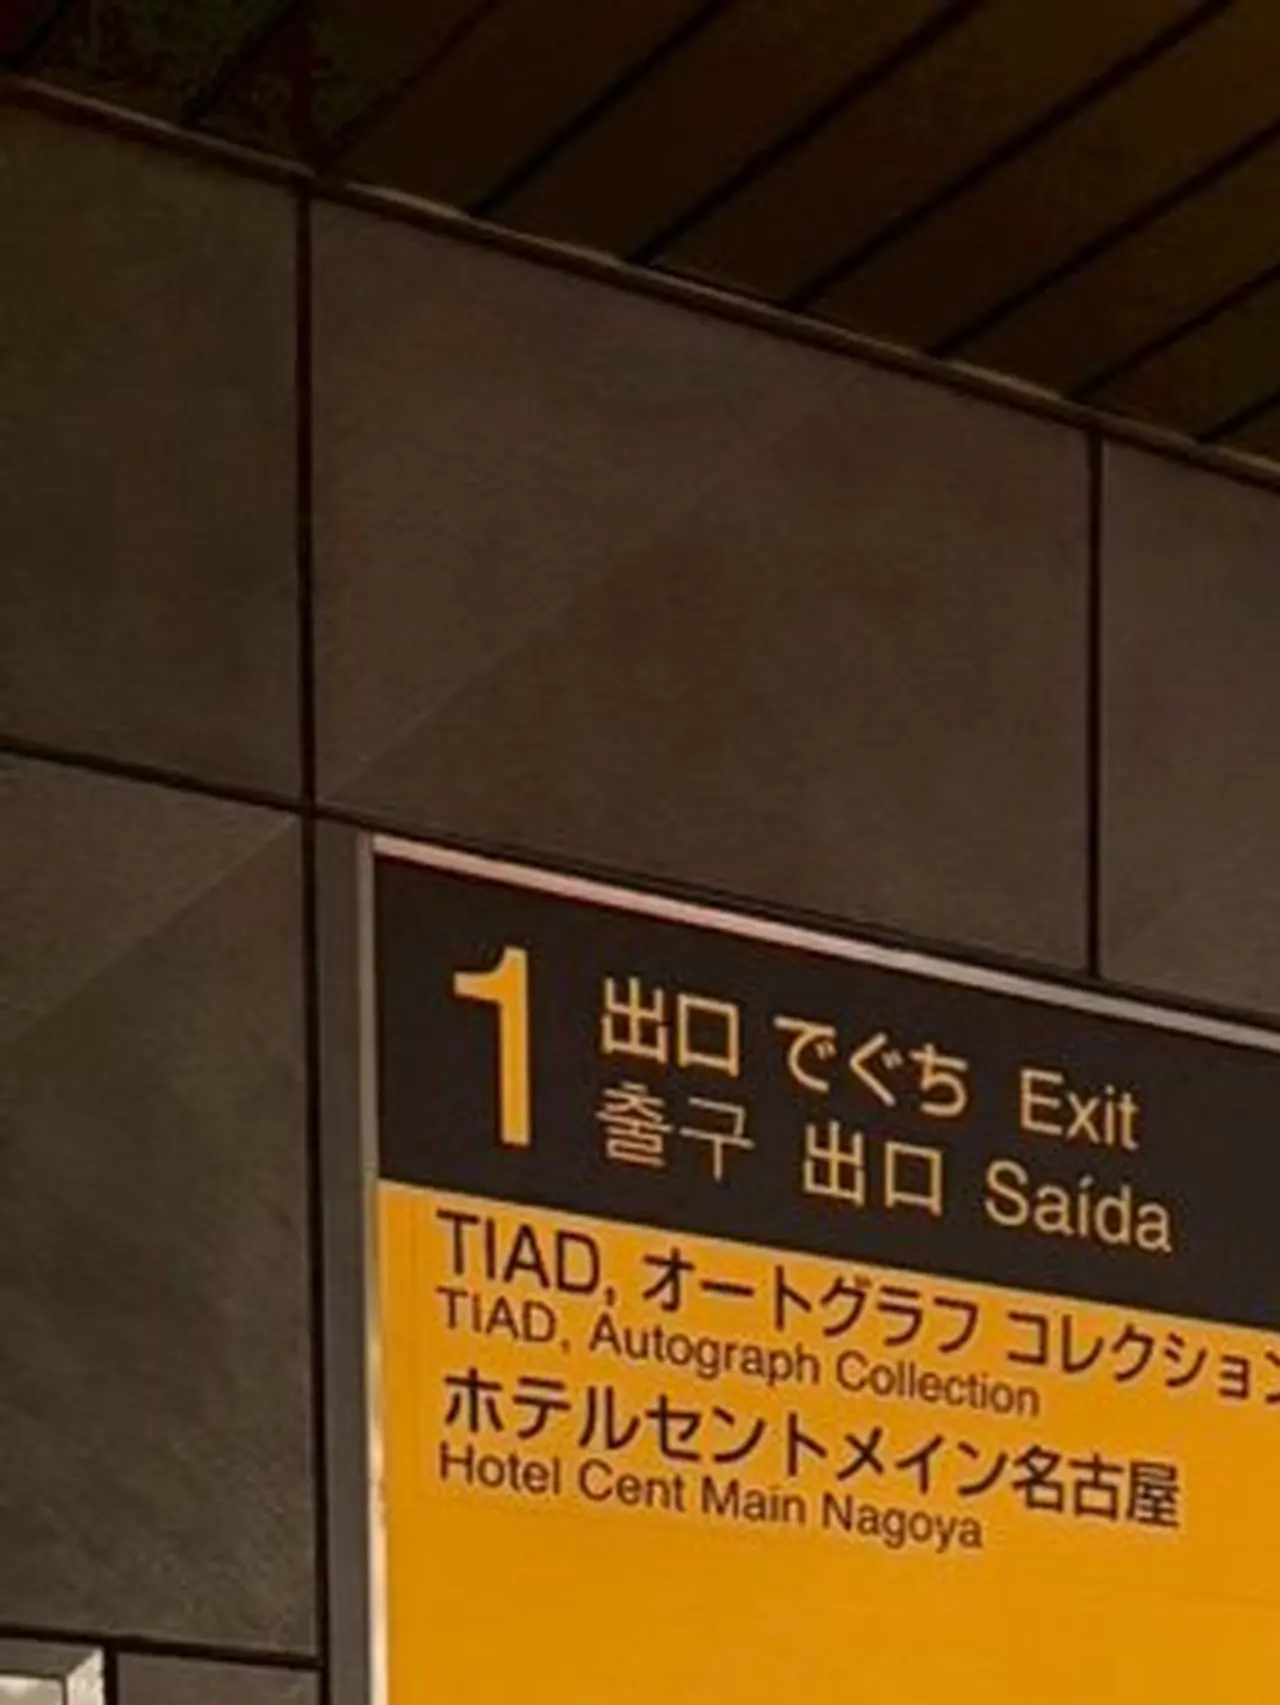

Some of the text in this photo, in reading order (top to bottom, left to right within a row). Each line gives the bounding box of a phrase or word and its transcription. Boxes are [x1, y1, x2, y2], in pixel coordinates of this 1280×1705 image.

[453, 945, 531, 1148] 1
[601, 976, 1140, 1151] 出口 でぐち Exit
[595, 1081, 1172, 1253] 출구 出口 Saída
[435, 1286, 1042, 1418] TIAD, Autograph Collection
[436, 1208, 616, 1306] TIAD,
[642, 1246, 979, 1354] オートグラフ
[439, 1440, 984, 1554] Hotel Cent Main Nagoya
[443, 1366, 1182, 1530] ホテルセントメイン名古屋
